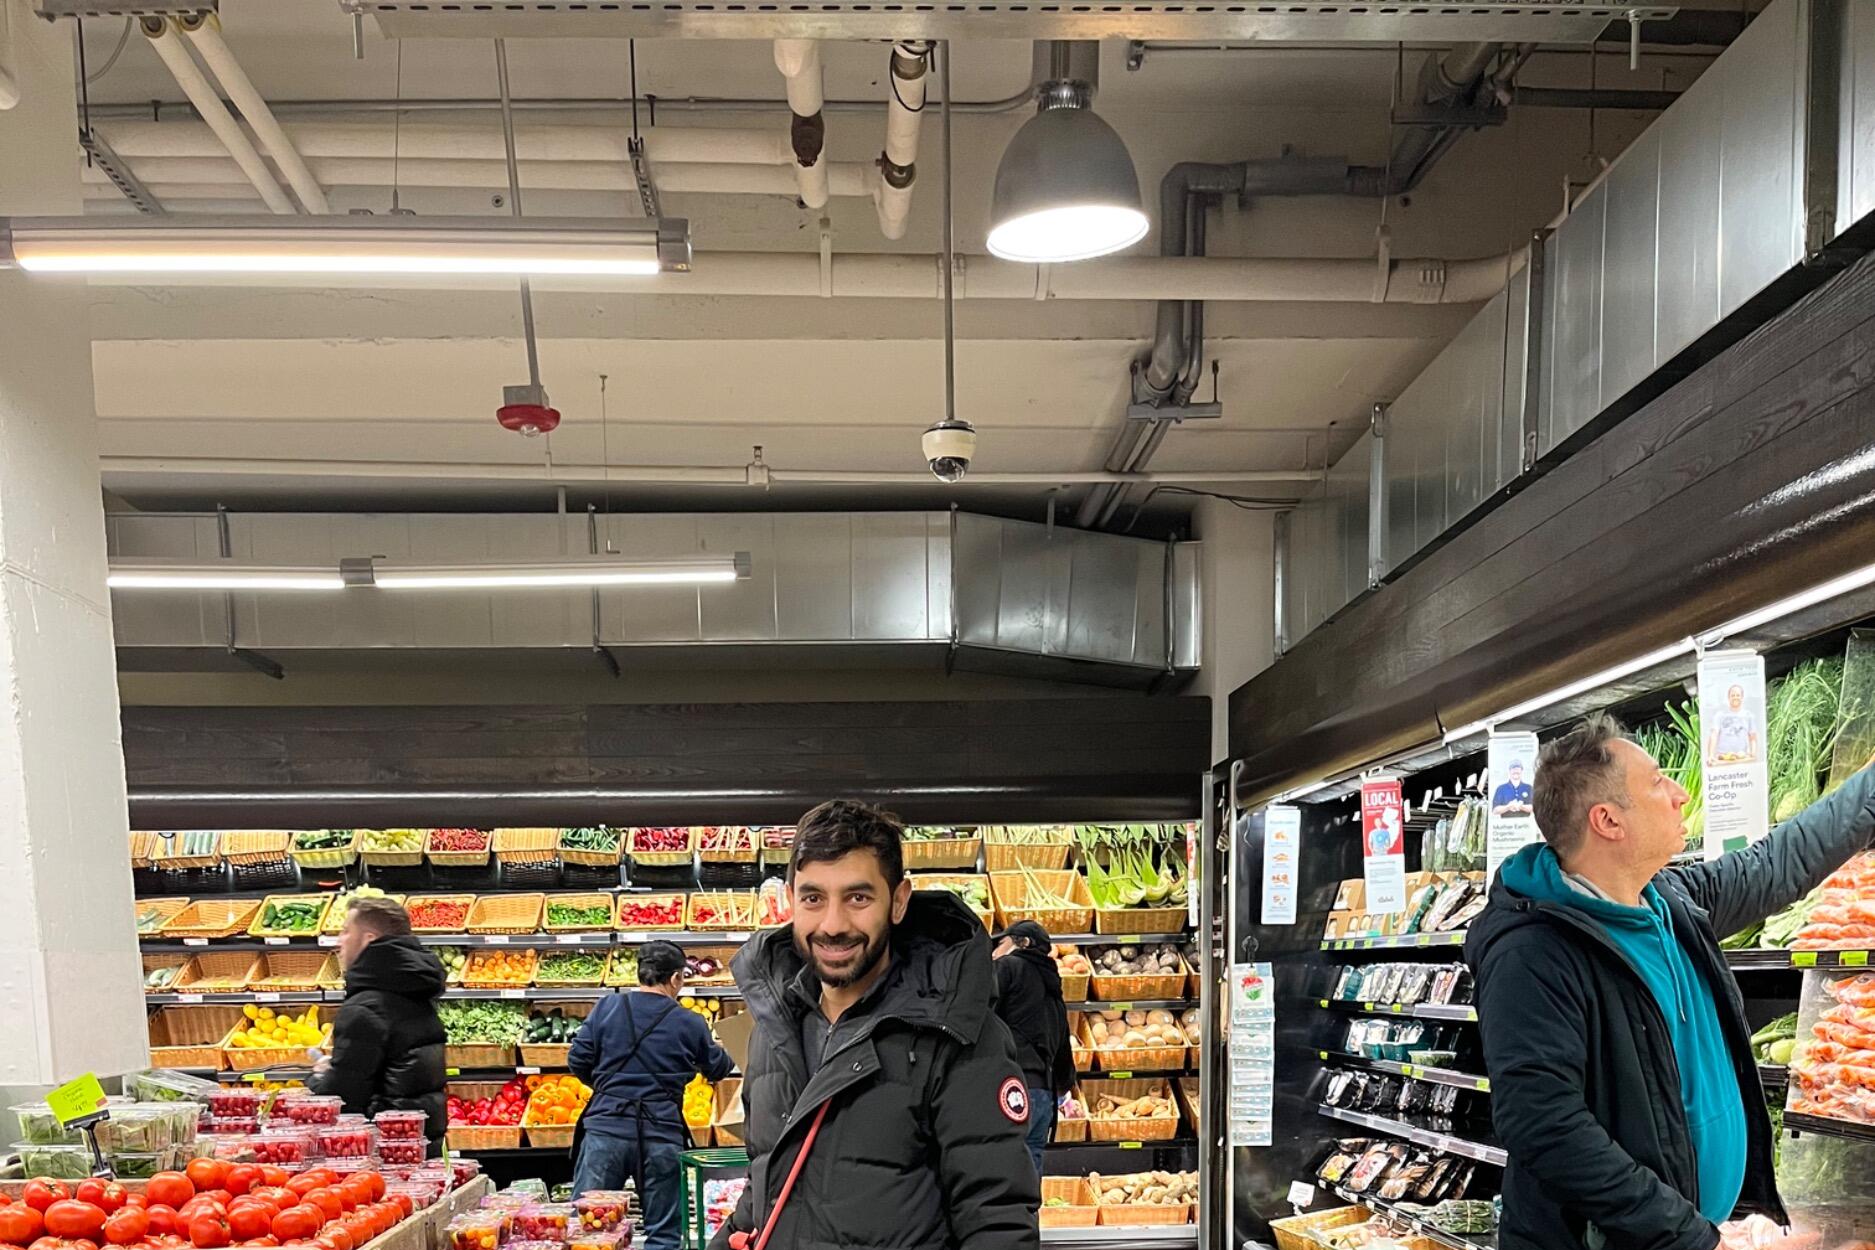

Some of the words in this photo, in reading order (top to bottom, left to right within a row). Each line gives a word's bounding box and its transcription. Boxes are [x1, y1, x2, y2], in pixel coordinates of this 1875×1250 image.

[1708, 772, 1748, 782] Lancaster
[1708, 783, 1729, 791] Farm
[1731, 780, 1753, 789] Fresh
[1365, 791, 1399, 807] LOCAL
[1708, 791, 1737, 800] Co-Op
